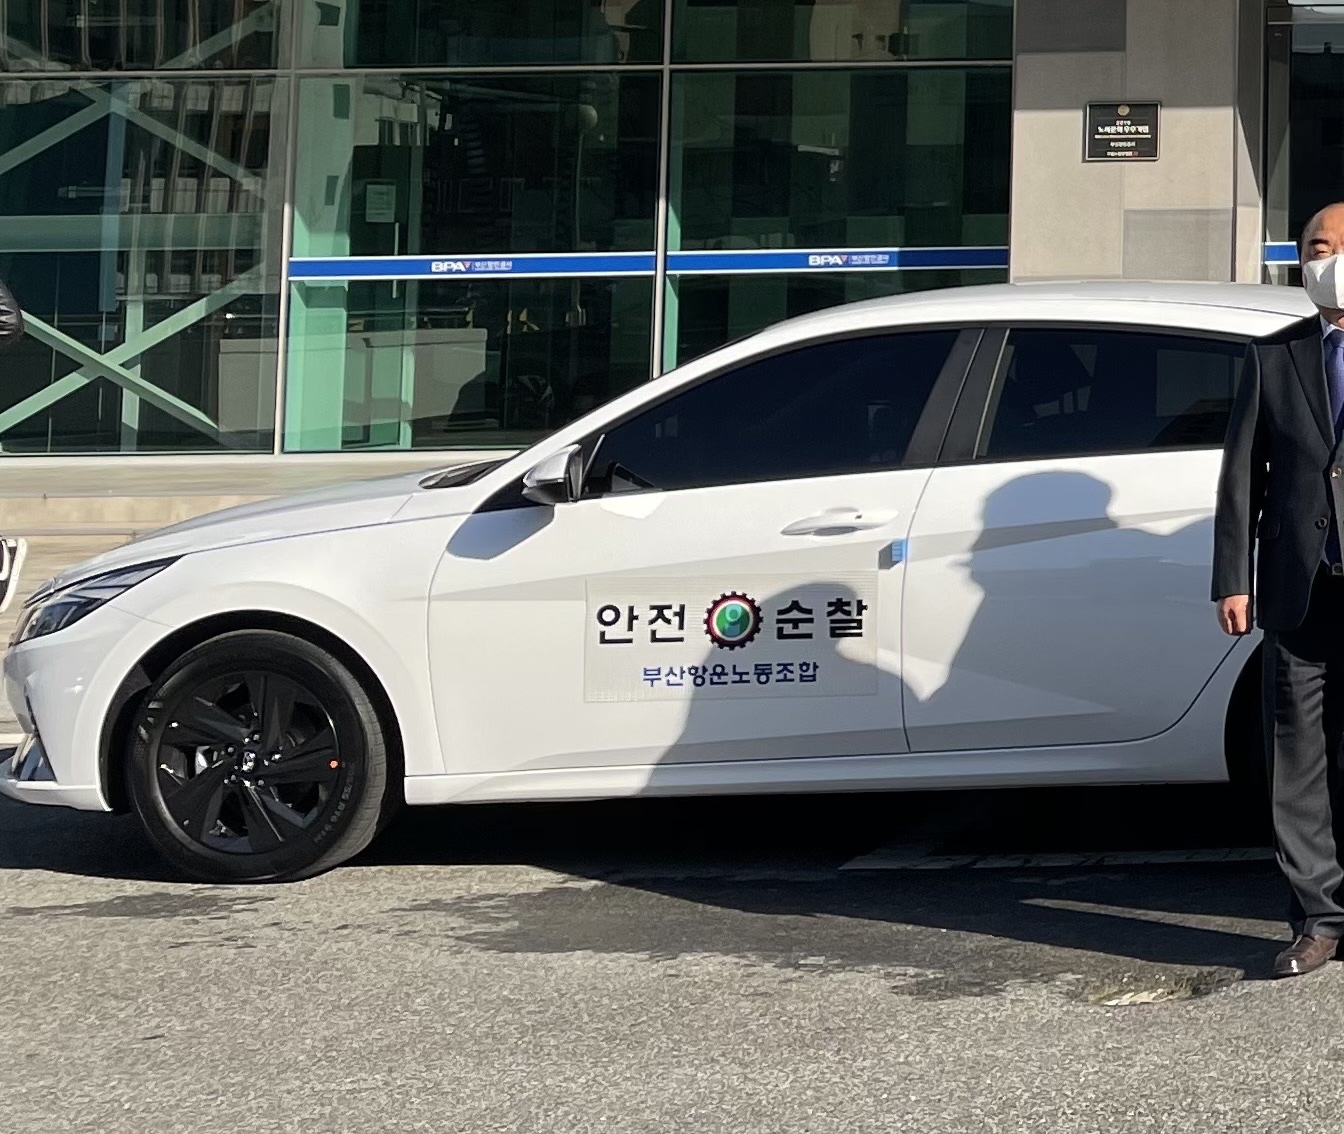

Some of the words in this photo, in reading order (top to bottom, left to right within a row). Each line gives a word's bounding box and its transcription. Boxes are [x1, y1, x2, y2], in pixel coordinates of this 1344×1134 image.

[431, 261, 467, 273] BPA
[808, 254, 843, 266] BPA
[596, 603, 687, 645] 안전
[775, 597, 869, 640] 순찰
[642, 661, 820, 687] 부산항운노동조합
